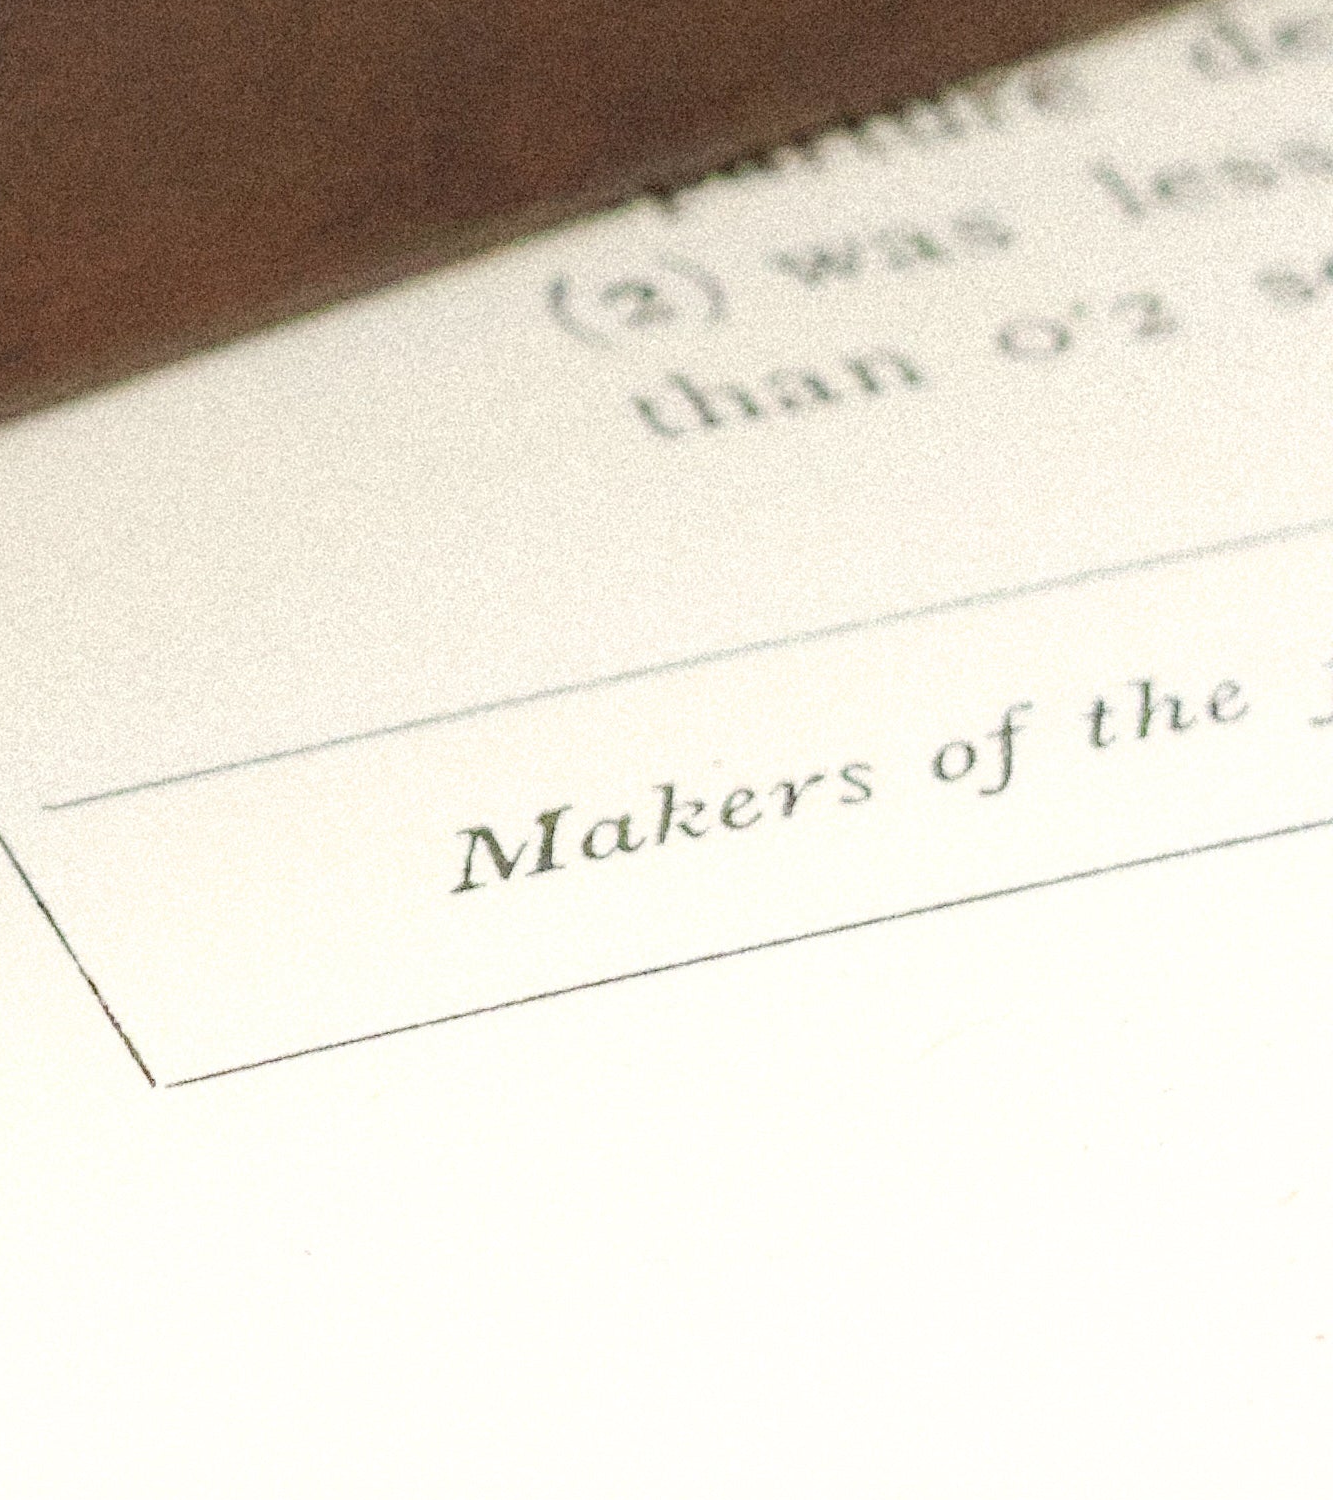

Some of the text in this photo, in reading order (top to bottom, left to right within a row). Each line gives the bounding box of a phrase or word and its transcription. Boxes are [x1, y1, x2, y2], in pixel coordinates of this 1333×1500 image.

[546, 258, 727, 350] (2)
[767, 210, 1015, 287] was
[630, 342, 927, 442] than
[450, 760, 875, 893] Makers
[931, 700, 1033, 796] of
[1084, 678, 1250, 749] the
